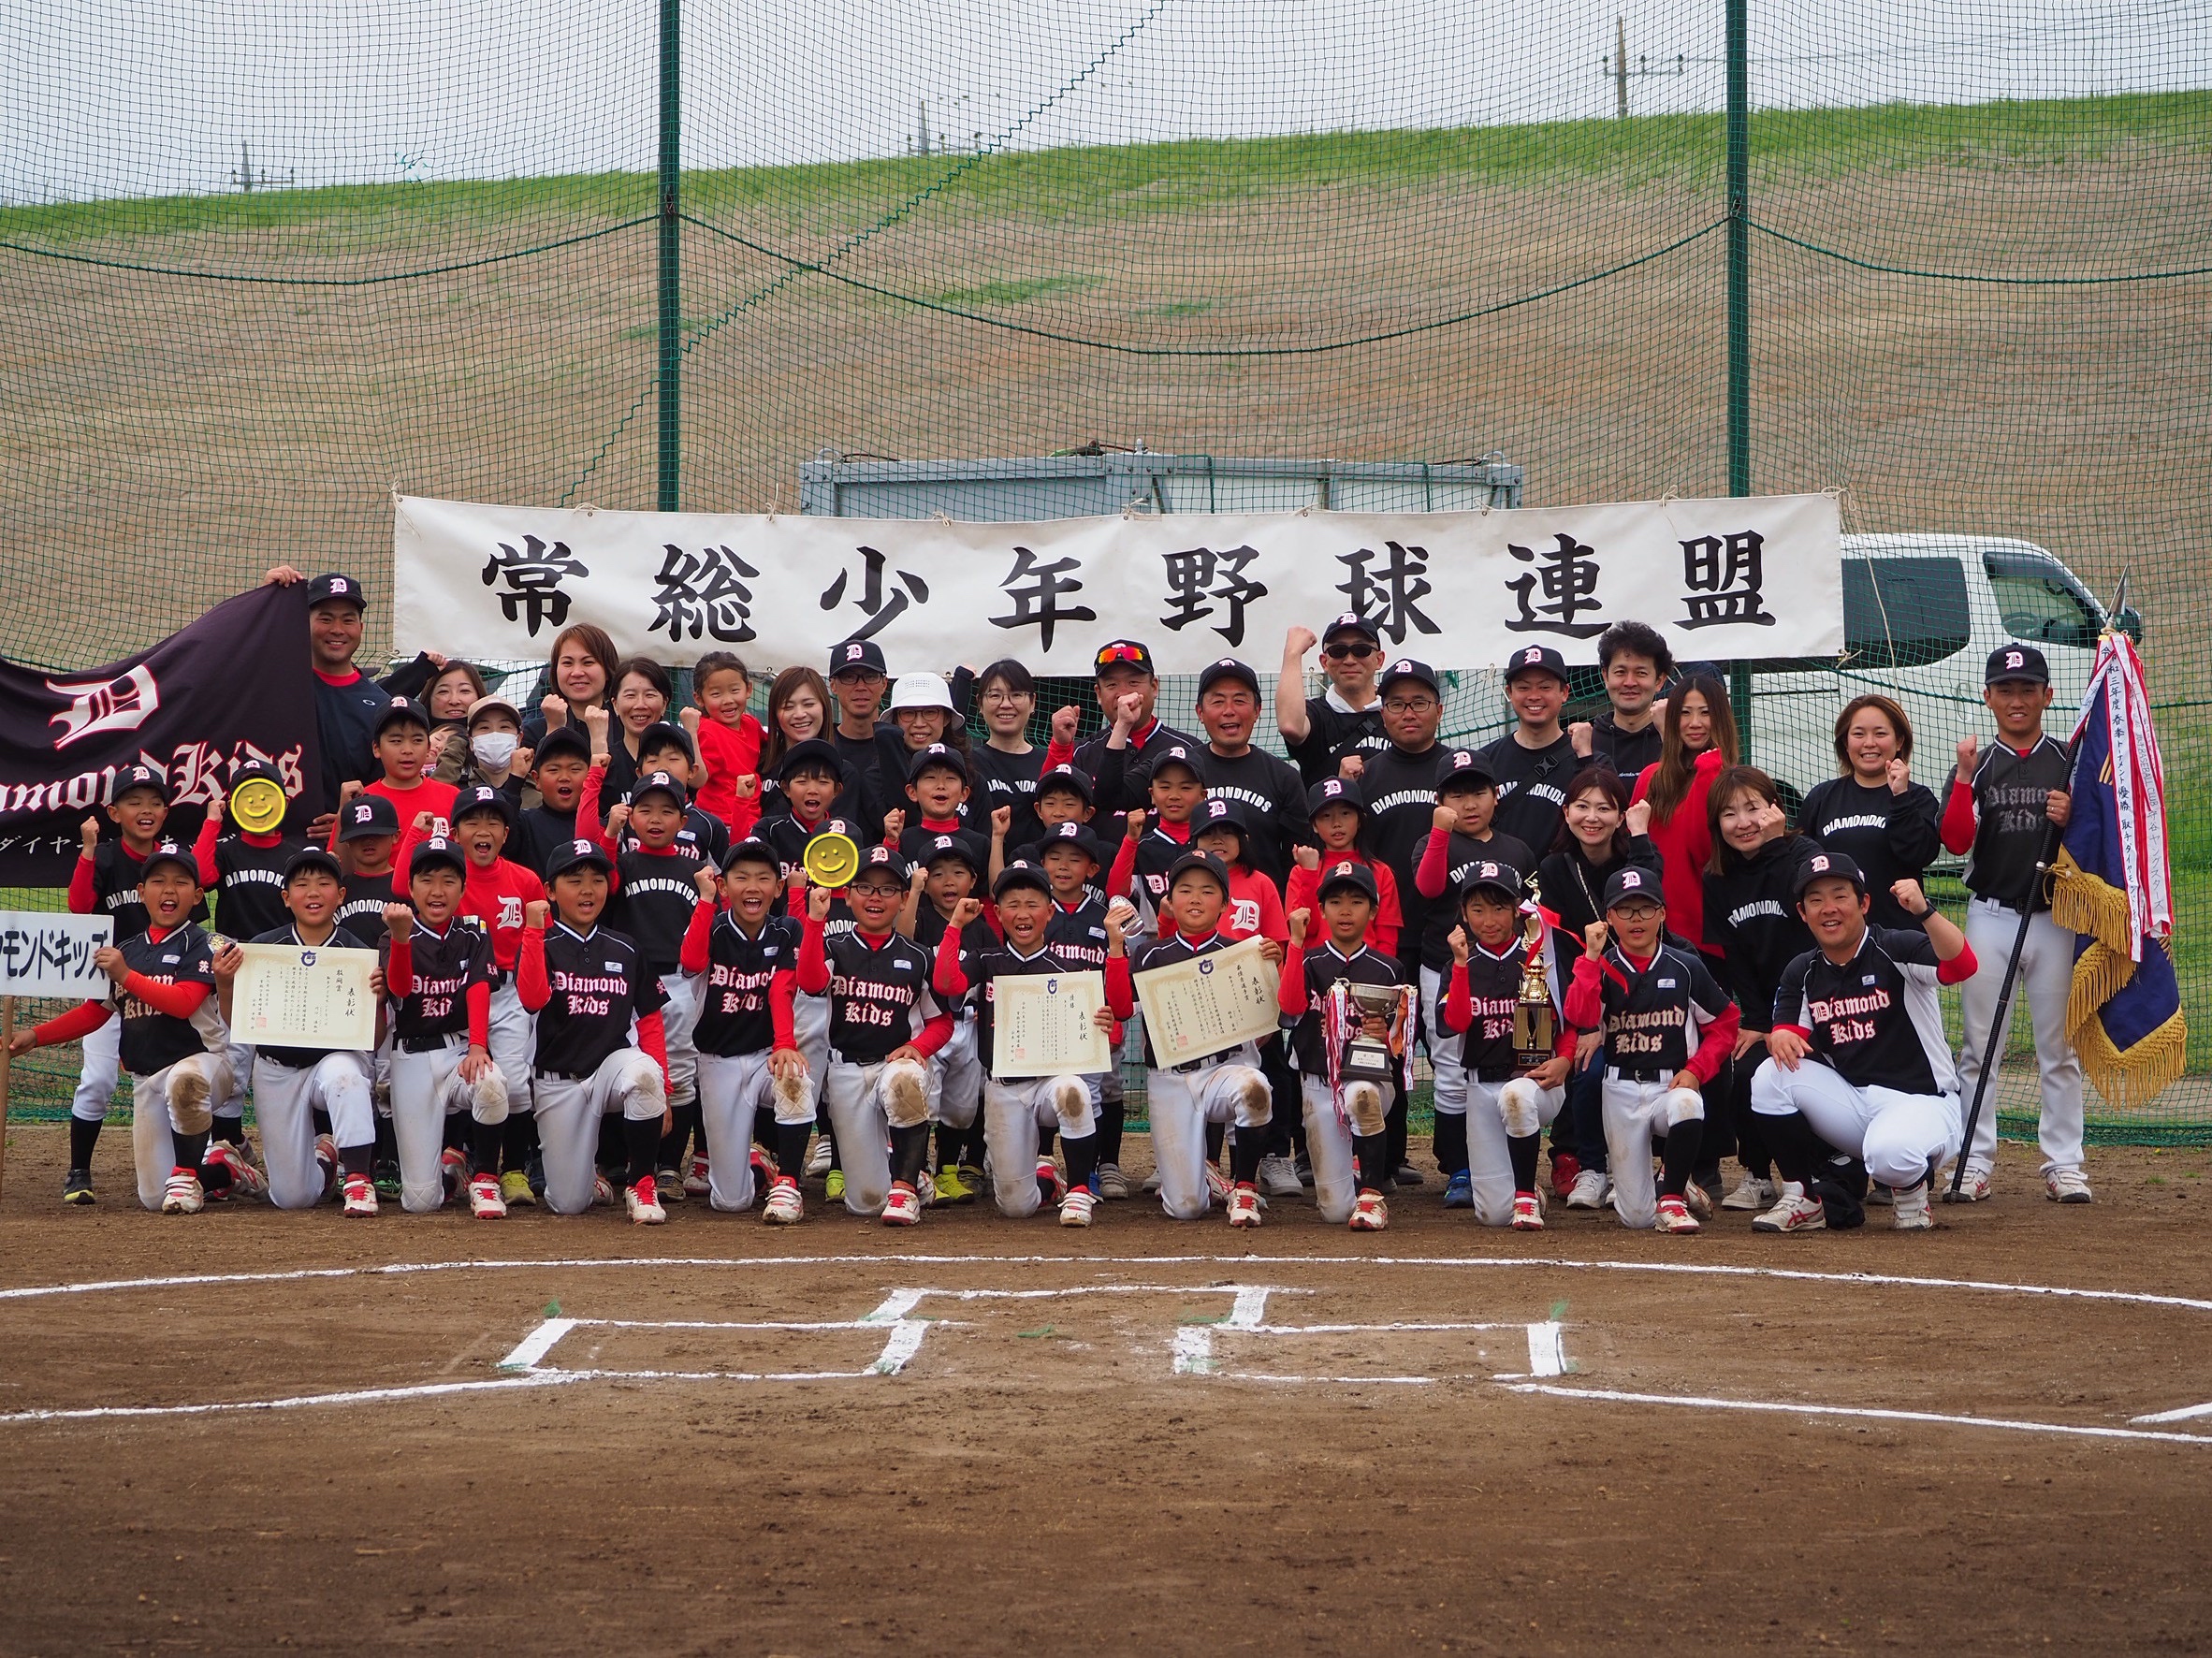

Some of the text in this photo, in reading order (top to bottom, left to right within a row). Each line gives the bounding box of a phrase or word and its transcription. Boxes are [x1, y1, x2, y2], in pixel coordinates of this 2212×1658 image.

[330, 577, 347, 593] D
[482, 530, 1776, 653] 常総少年野球連盟
[1340, 613, 1357, 625] D
[847, 644, 863, 661] D
[1524, 647, 1542, 663] D
[2005, 651, 2024, 669] D
[1395, 660, 1412, 673] D
[46, 662, 160, 750] D
[391, 696, 408, 707] D
[1170, 747, 1186, 759] D
[1453, 751, 1472, 768] D
[133, 765, 150, 780] D
[1055, 764, 1072, 774] D
[652, 772, 670, 786] D
[1323, 779, 1342, 796] D
[475, 786, 493, 800] D
[355, 805, 372, 823] D
[1208, 800, 1227, 818] D
[431, 817, 449, 837] D
[829, 820, 845, 834] D
[1059, 822, 1077, 836] D
[159, 843, 177, 854] D
[429, 836, 446, 850] D
[573, 839, 592, 855] D
[935, 835, 953, 849] D
[870, 847, 888, 863] D
[1811, 855, 1829, 872] D
[1335, 861, 1353, 877] D
[1479, 863, 1498, 878] D
[1622, 871, 1641, 889] D
[496, 895, 523, 930] D
[1230, 896, 1259, 932] D
[0, 929, 109, 981] モンドキッズ
[552, 971, 628, 996] Diamond
[832, 975, 913, 1006] Diamond
[568, 995, 609, 1016] Kids
[845, 1002, 894, 1026] Kids
[1809, 990, 1891, 1024] Diamond
[1608, 1004, 1684, 1033] Diamond
[1830, 1020, 1876, 1044] Kids
[1615, 1032, 1663, 1054] Kids
